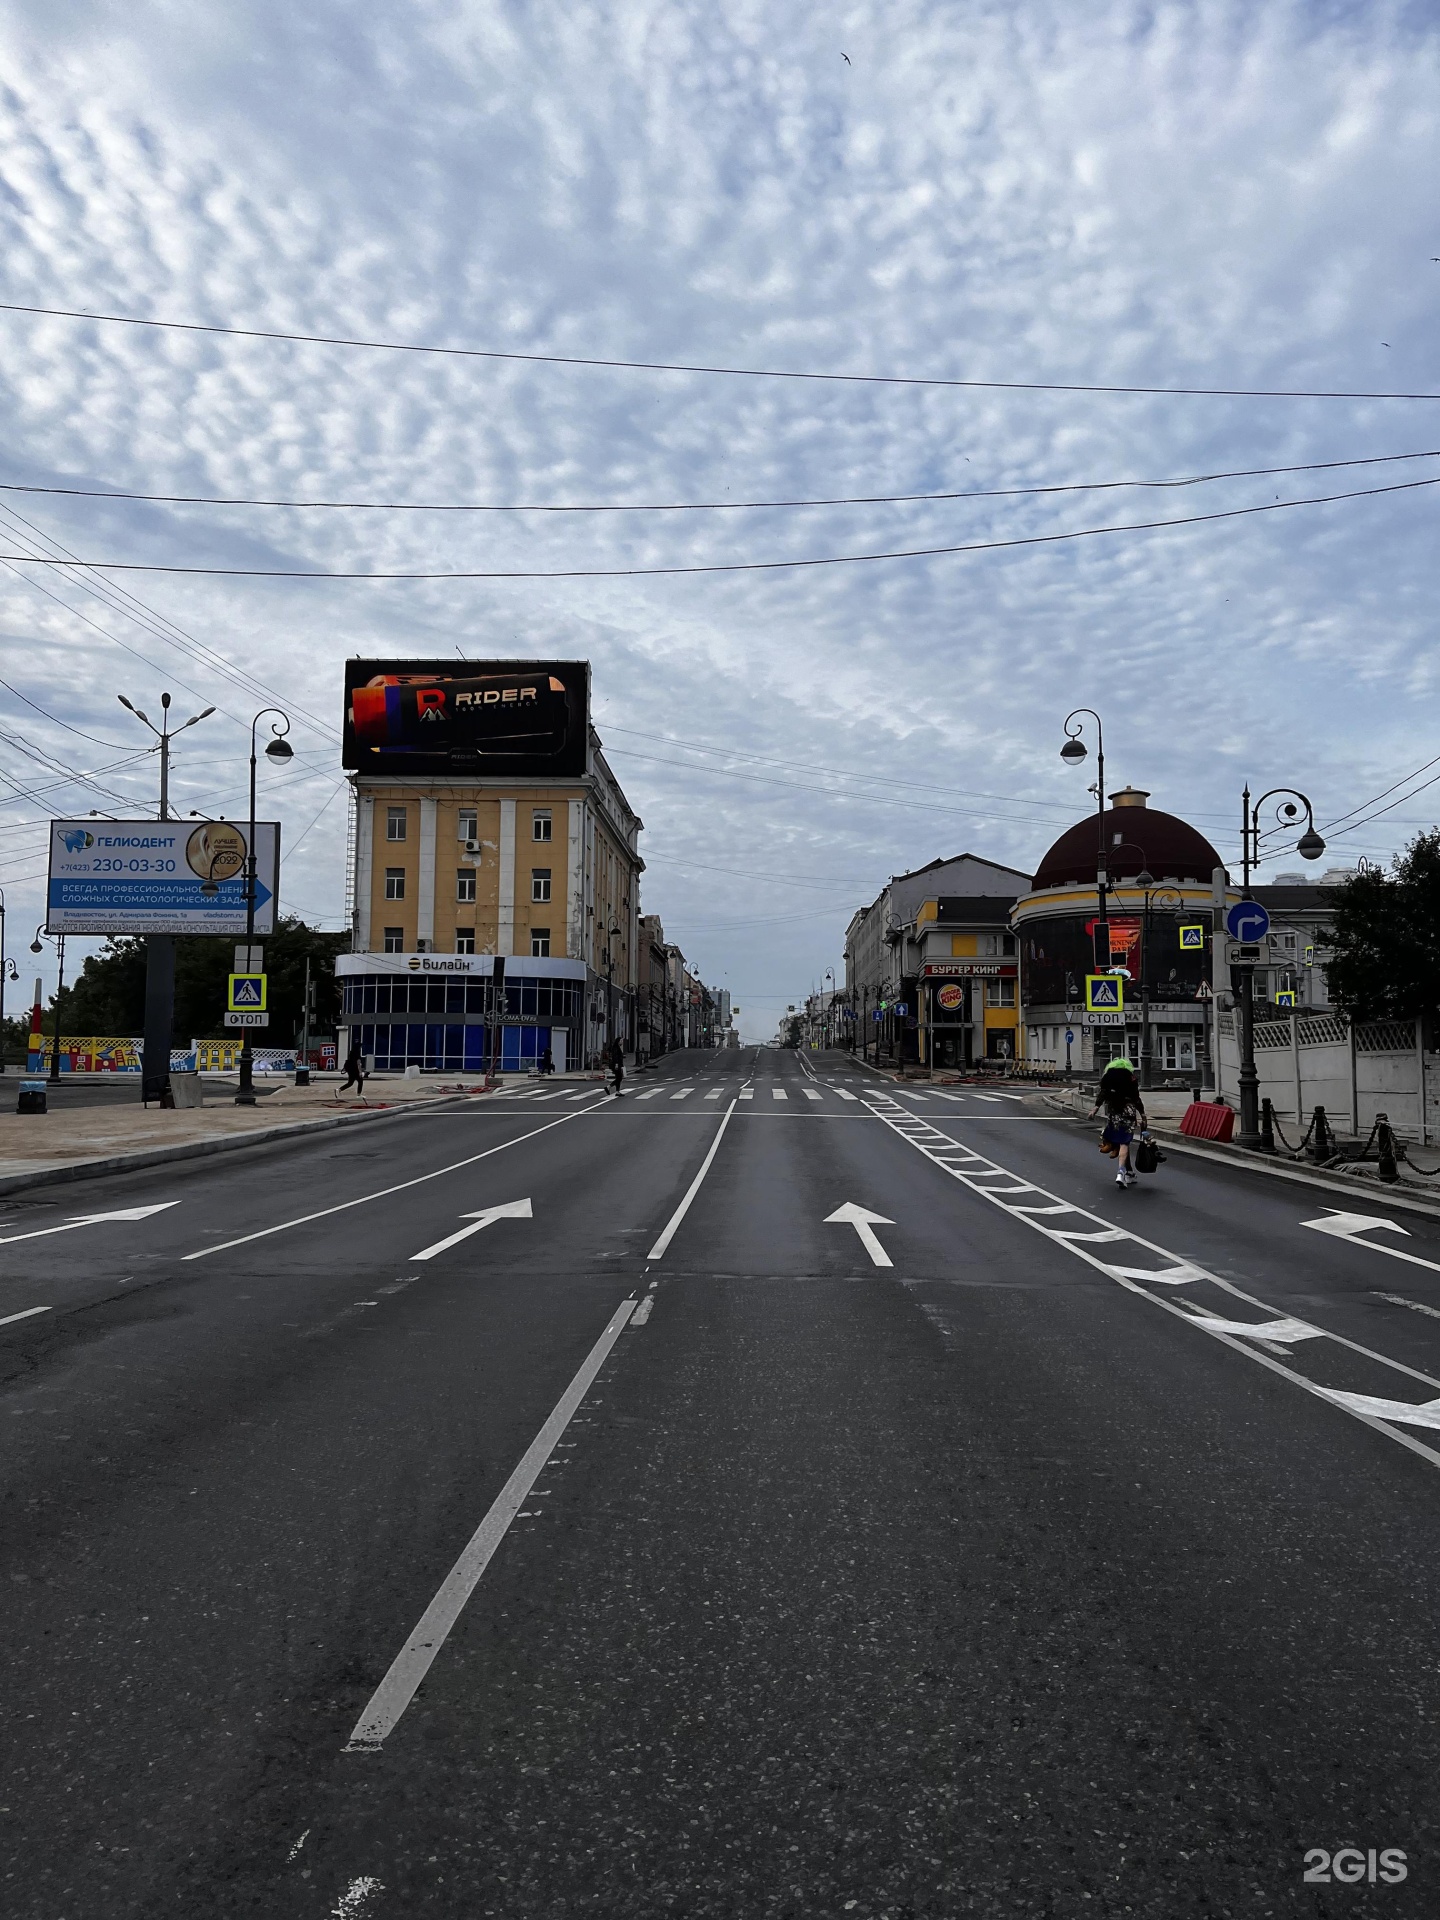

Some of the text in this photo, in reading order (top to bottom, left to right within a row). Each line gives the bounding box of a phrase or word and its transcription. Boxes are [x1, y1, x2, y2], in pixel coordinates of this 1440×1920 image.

[455, 687, 537, 706] RIDER
[494, 701, 538, 709] ENERGY
[97, 837, 175, 848] ГЕЛИОДЕНТ
[214, 856, 237, 864] 2022
[93, 859, 176, 872] 230-03-30
[62, 885, 98, 893] ВСЕГДА
[221, 897, 248, 905] ЗАДА
[143, 924, 182, 932] НЕОБХОДИМА
[422, 958, 470, 971] Билайн
[931, 965, 1000, 974] БУРГЕР КИНГ
[941, 988, 961, 998] BURGER
[942, 993, 962, 1004] KING
[1088, 1014, 1119, 1023] СТОП
